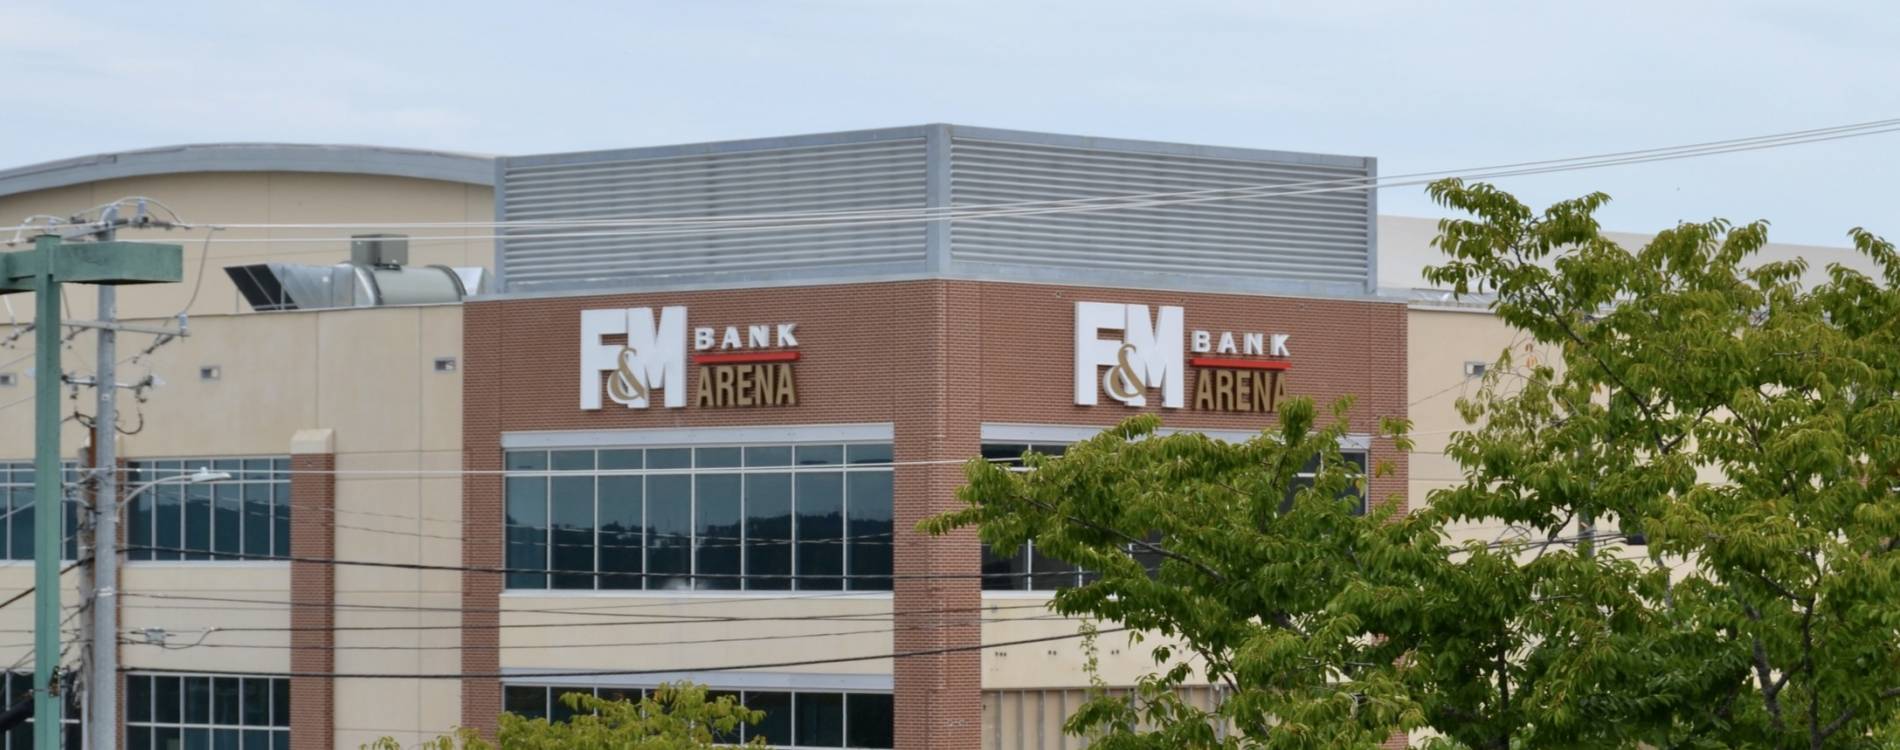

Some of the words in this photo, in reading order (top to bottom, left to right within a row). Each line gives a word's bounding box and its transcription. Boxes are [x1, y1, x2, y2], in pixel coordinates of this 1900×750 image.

[580, 306, 688, 410] F&M
[694, 323, 798, 350] BANK
[1074, 302, 1184, 409] F&M
[1190, 330, 1290, 356] BANK
[696, 363, 796, 408] ARENA
[1194, 368, 1287, 412] ARENA
